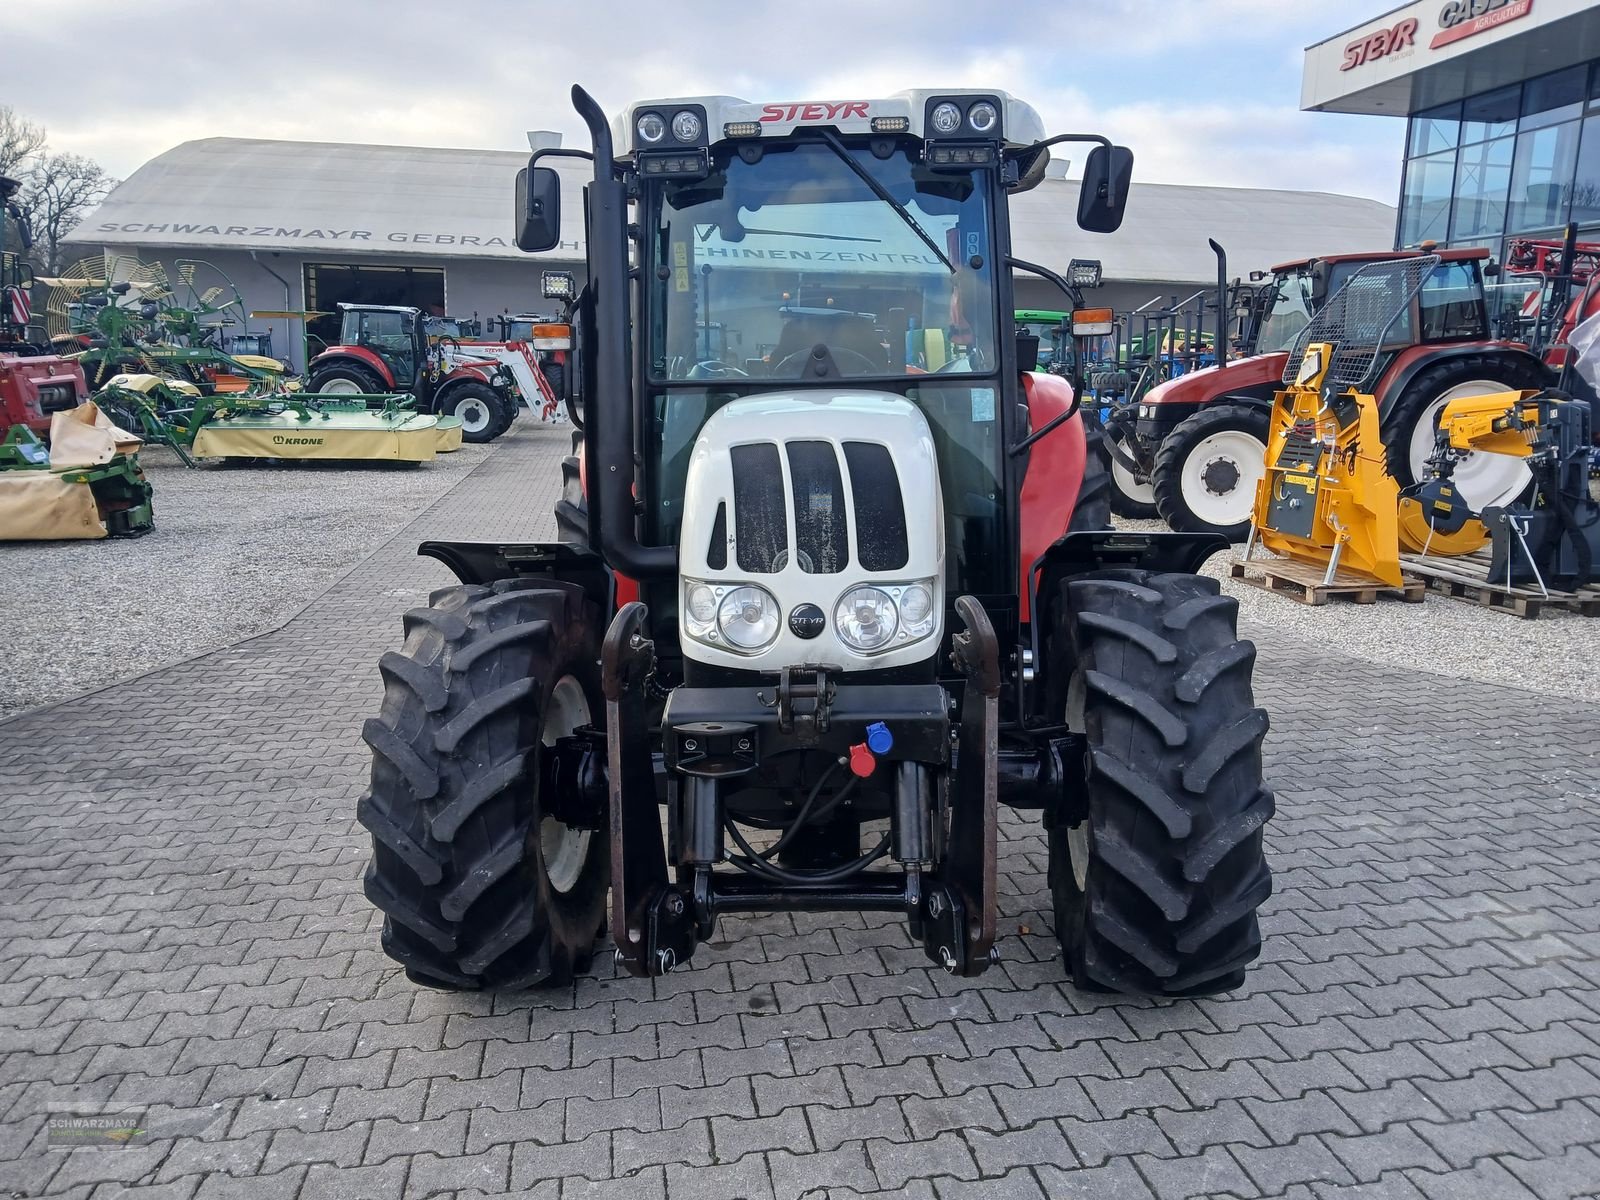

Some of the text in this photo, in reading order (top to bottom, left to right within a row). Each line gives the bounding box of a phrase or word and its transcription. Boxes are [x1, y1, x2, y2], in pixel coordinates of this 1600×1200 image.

[1474, 2, 1527, 31] AGRICULTURE
[1340, 17, 1418, 71] STEYR
[758, 101, 870, 122] STEYR
[96, 223, 372, 240] SCHWARZMAYR
[791, 617, 824, 625] STEYR
